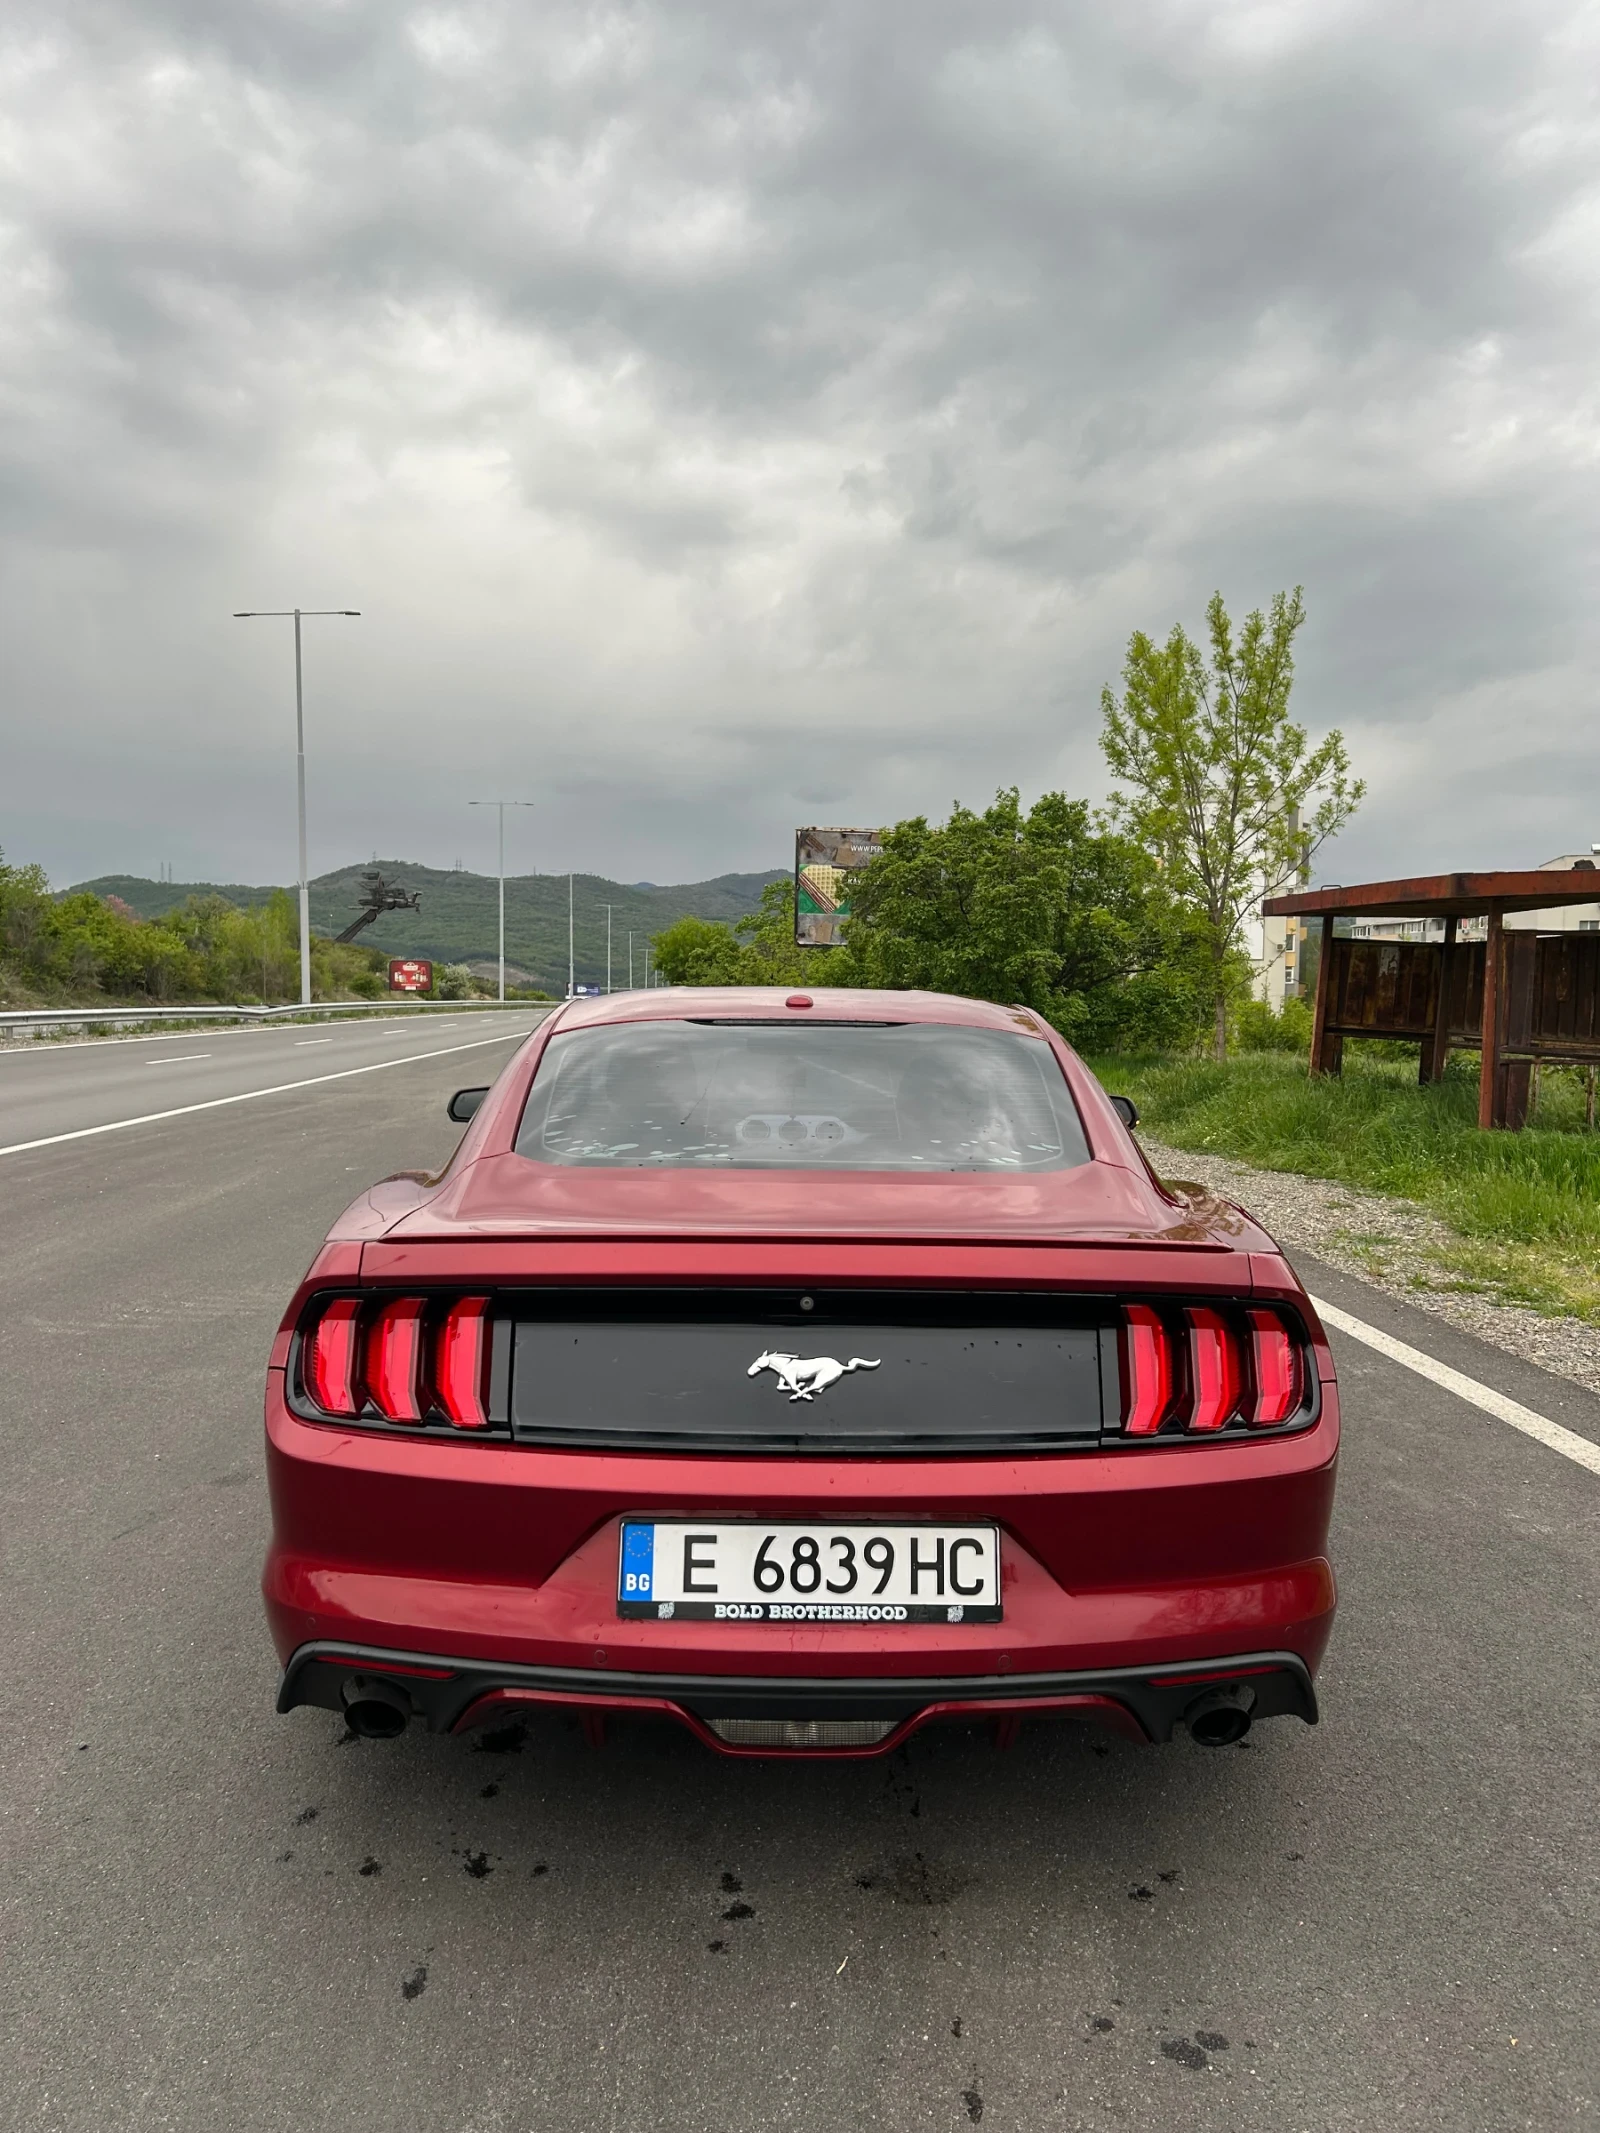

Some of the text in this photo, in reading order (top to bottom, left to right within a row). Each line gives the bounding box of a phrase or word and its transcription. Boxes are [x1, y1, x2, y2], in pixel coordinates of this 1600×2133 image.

[683, 1534, 718, 1593] E
[753, 1535, 895, 1595] 6839
[625, 1573, 650, 1592] BG
[714, 1604, 764, 1619] BOLD
[769, 1605, 908, 1620] BROTHERHOOD
